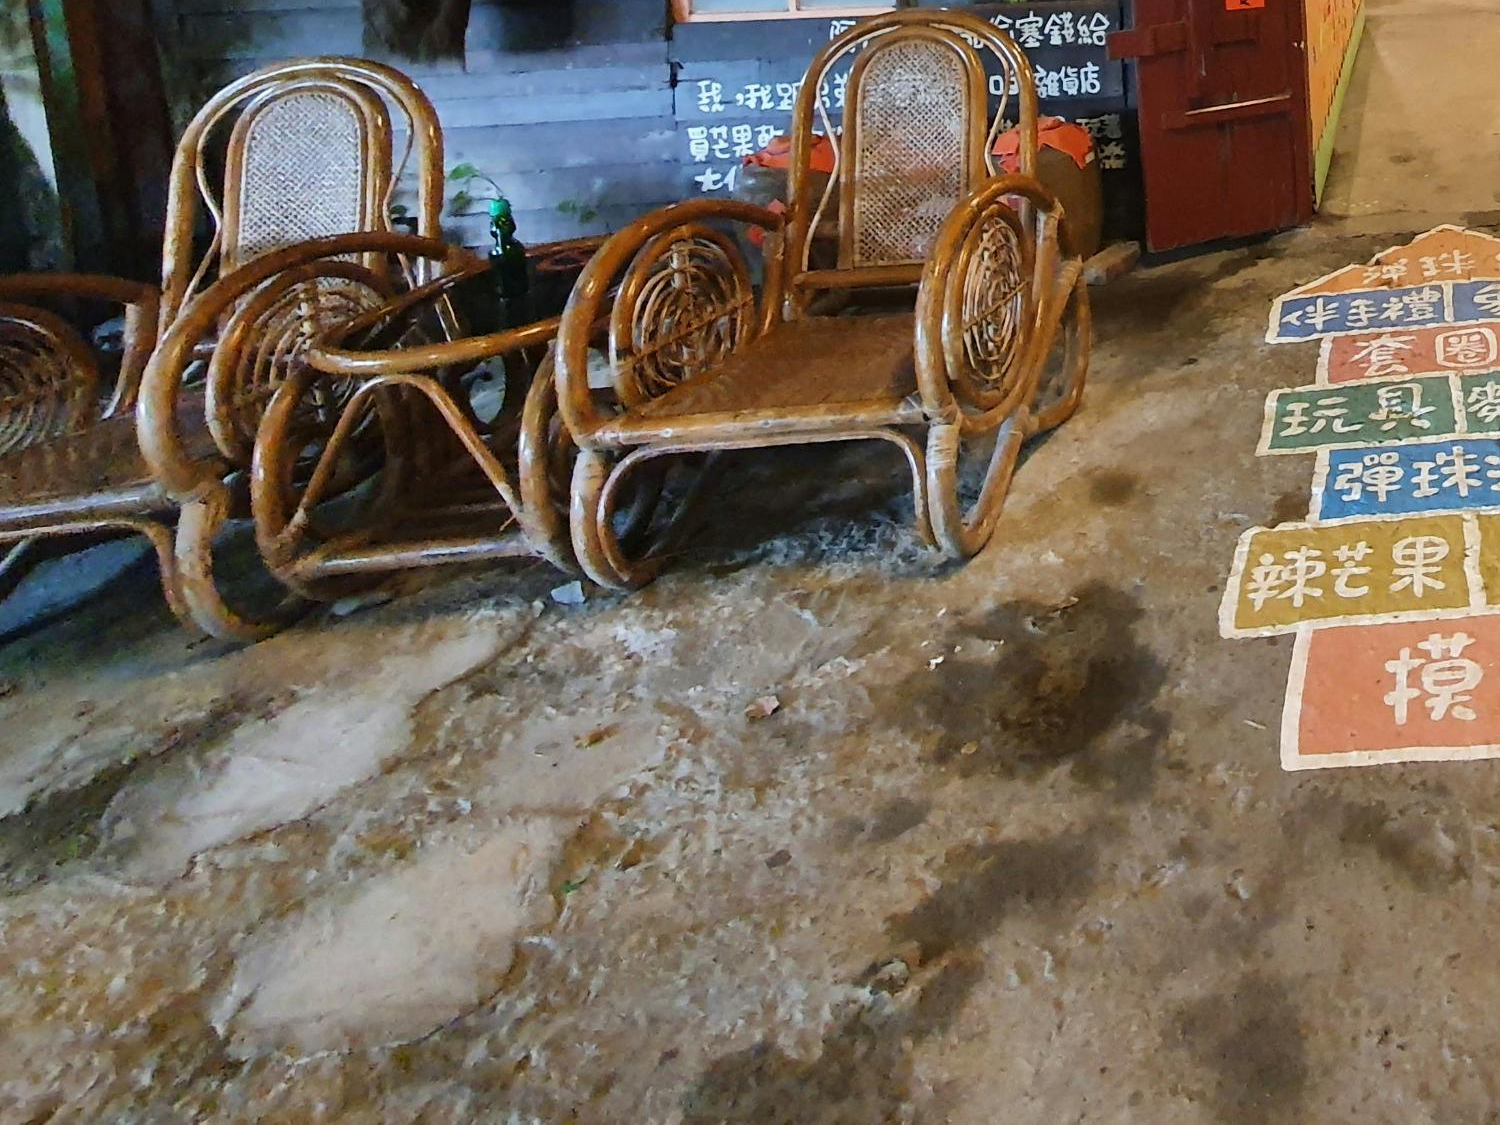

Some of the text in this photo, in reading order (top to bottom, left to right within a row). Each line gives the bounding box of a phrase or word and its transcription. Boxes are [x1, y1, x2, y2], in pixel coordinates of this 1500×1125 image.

[1281, 289, 1442, 330] 伴手禮
[1279, 382, 1437, 437] 玩具
[1246, 534, 1451, 611] 辣芒果
